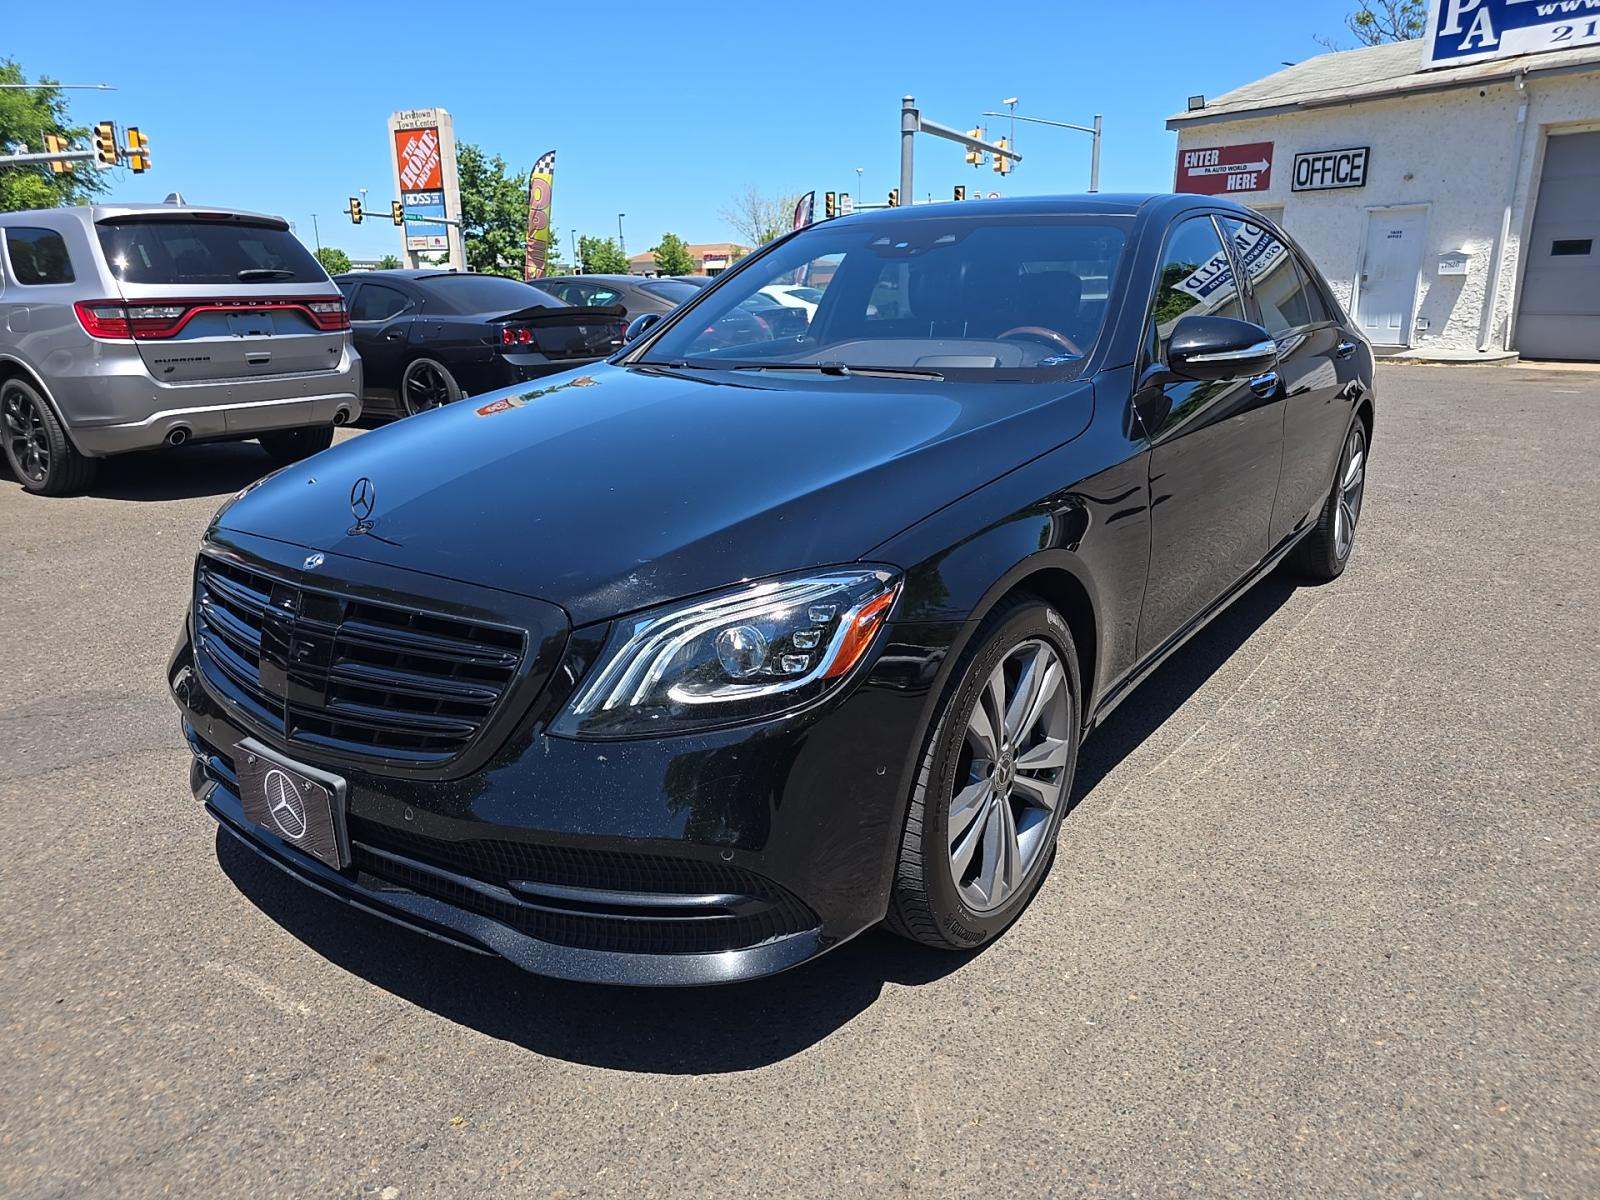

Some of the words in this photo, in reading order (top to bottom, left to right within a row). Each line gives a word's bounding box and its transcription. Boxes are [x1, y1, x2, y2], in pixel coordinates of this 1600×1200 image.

[400, 109, 431, 120] Levittown
[397, 120, 414, 130] Town
[414, 119, 437, 128] Center
[402, 136, 418, 161] THE
[401, 129, 437, 190] HOME
[1184, 150, 1219, 168] ENTER
[416, 150, 440, 190] DEPOT
[1296, 152, 1363, 186] OFFICE
[1226, 173, 1257, 191] HERE
[405, 193, 431, 206] ROSS
